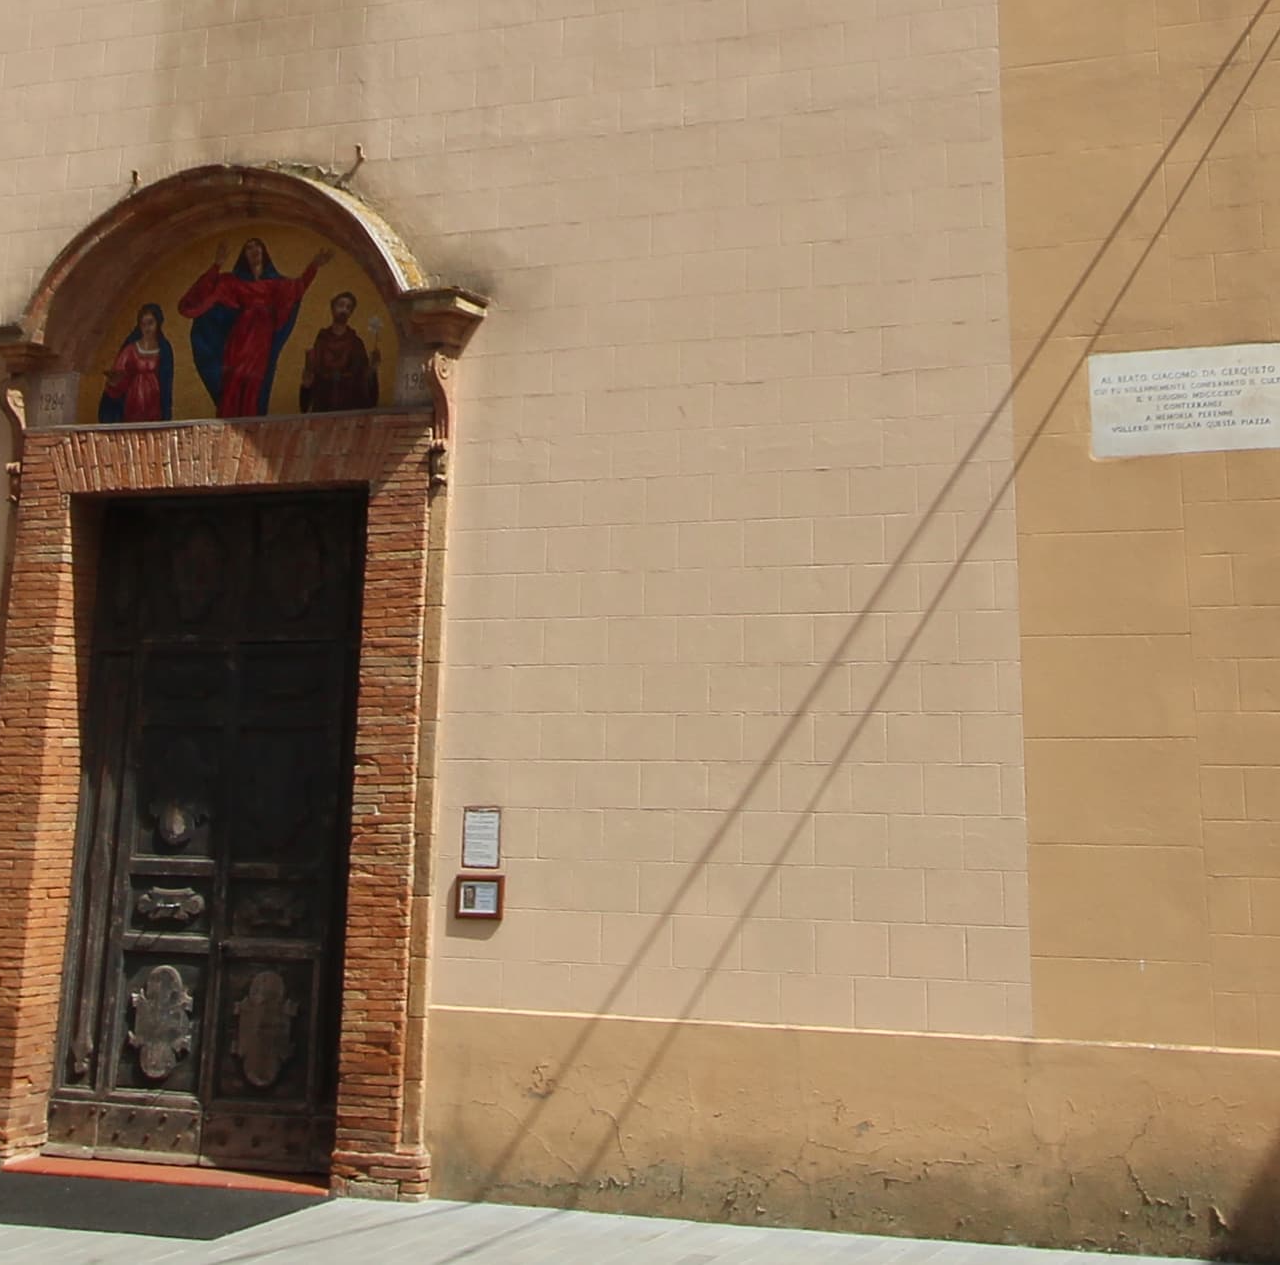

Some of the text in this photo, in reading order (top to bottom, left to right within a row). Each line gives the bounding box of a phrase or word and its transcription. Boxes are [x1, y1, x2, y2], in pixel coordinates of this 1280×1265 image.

[405, 373, 425, 390] 198
[1100, 376, 1112, 384] AL
[1117, 373, 1147, 383] BEATO
[1151, 370, 1197, 381] GIACOMO
[1221, 365, 1275, 376] CERQUETO
[1191, 378, 1247, 389] CONFERMATO
[1145, 409, 1233, 422] A MEMORIA PERENNE
[1111, 417, 1271, 433] VOLLERO INTITOLATA QUESTA PIAZZA
